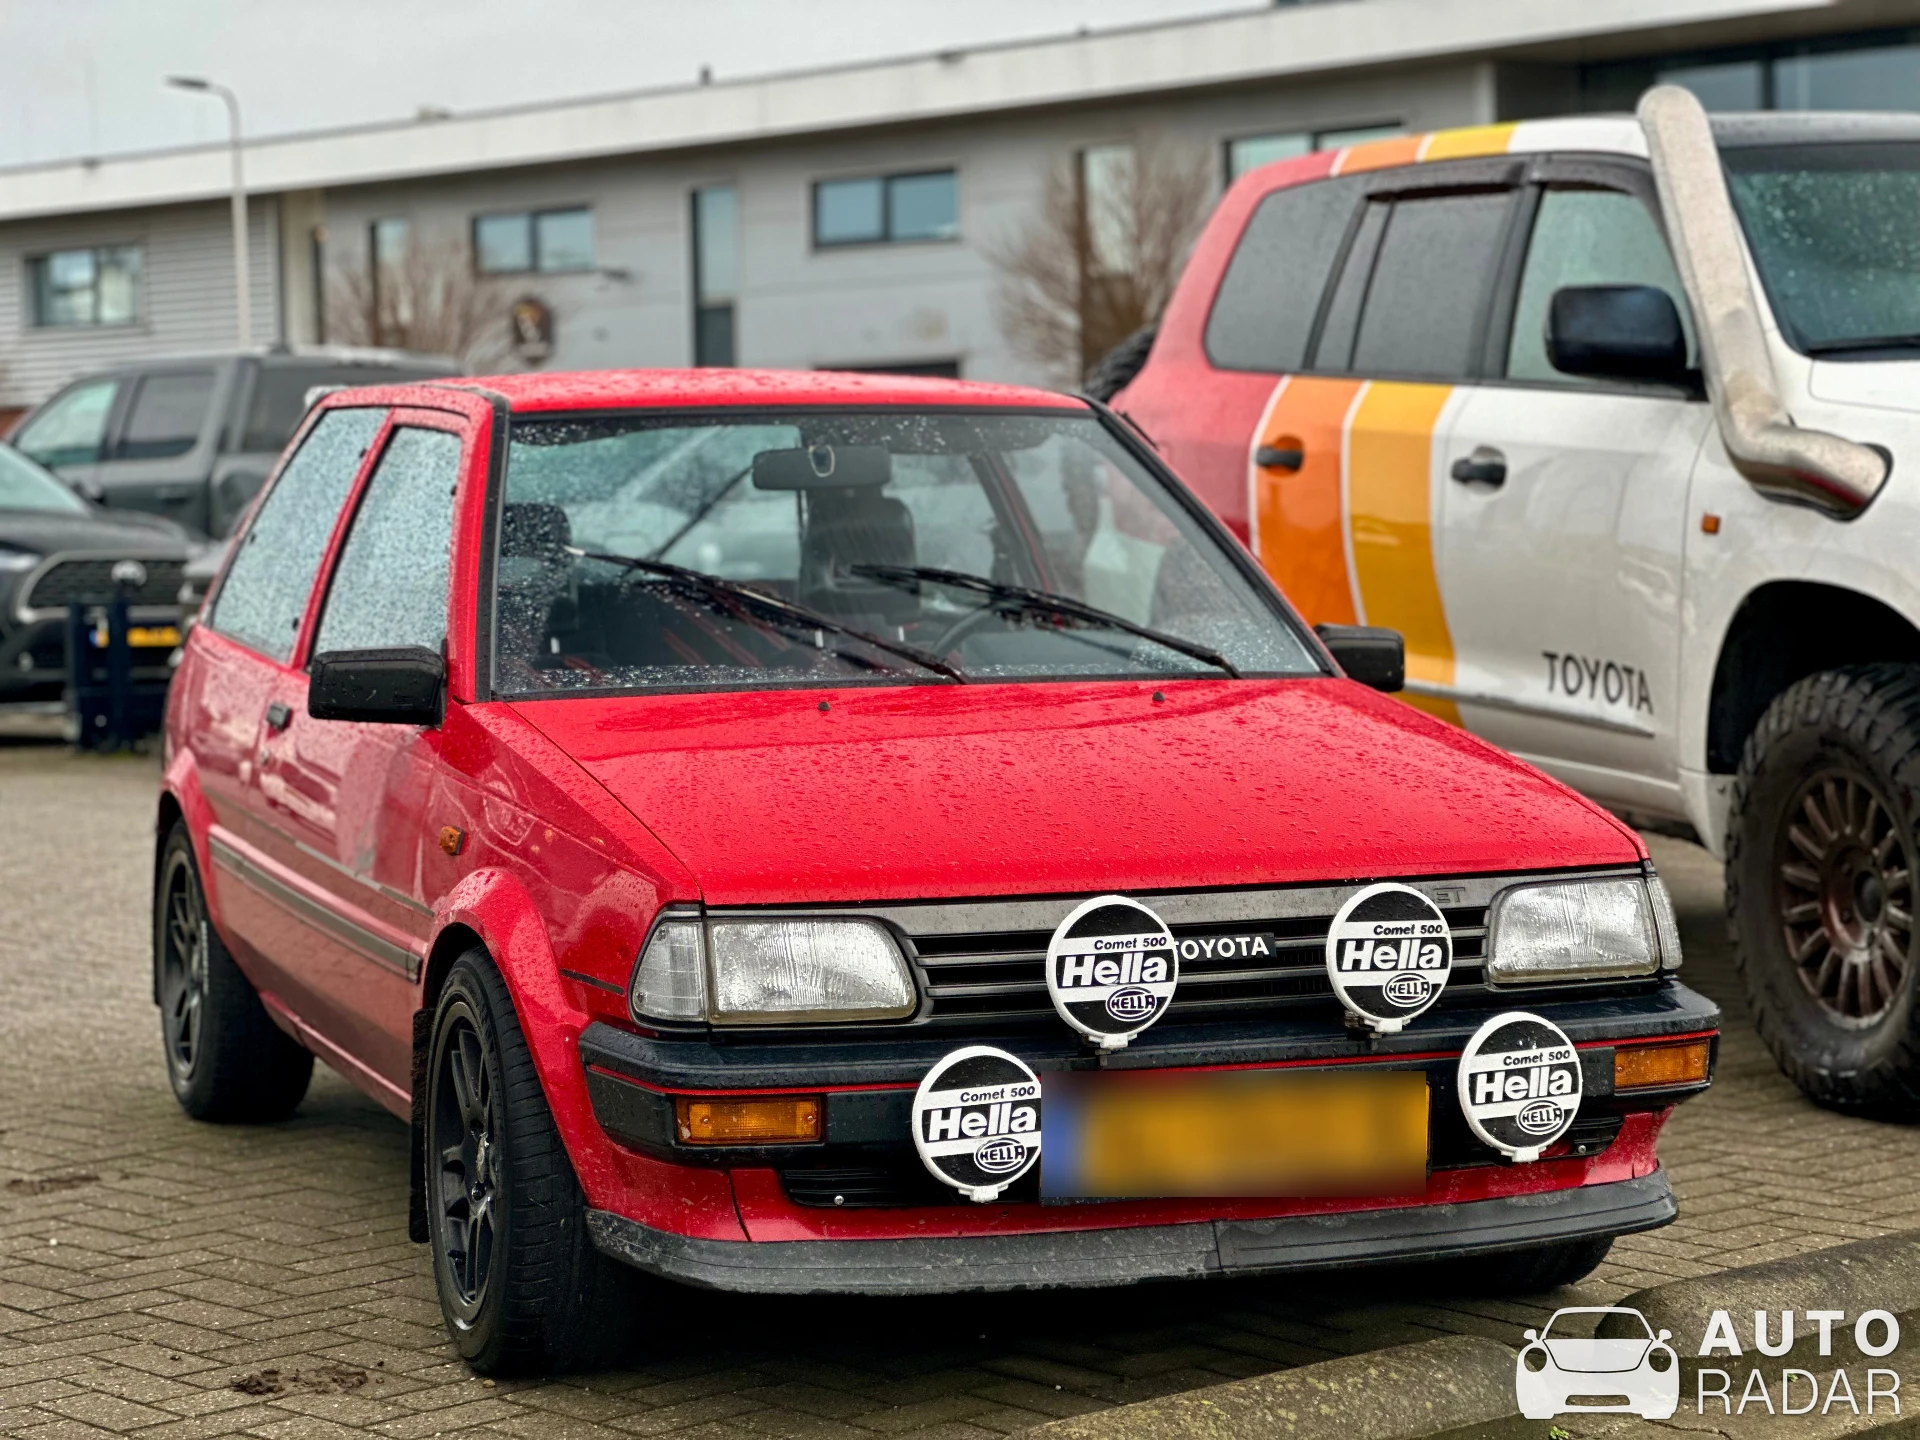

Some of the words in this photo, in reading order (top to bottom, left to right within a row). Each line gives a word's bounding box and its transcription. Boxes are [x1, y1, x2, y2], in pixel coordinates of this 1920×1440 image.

[1542, 650, 1654, 716] TOYOTA
[1373, 923, 1415, 936] Comet
[1420, 924, 1443, 935] 500
[1094, 937, 1137, 950] Comet
[1142, 936, 1167, 947] 500
[1341, 938, 1443, 970] Hella
[1061, 952, 1168, 987] Hella
[1388, 981, 1430, 996] HELLA
[1112, 994, 1155, 1010] HELLA
[1503, 1052, 1544, 1066] Comet
[1548, 1050, 1571, 1061] 500
[1475, 1066, 1573, 1104] Hella
[960, 1088, 1005, 1103] Comet
[1010, 1085, 1035, 1098] 500
[928, 1102, 1037, 1142] Hella
[1522, 1107, 1562, 1123] HELLA
[979, 1145, 1025, 1161] HELLA
